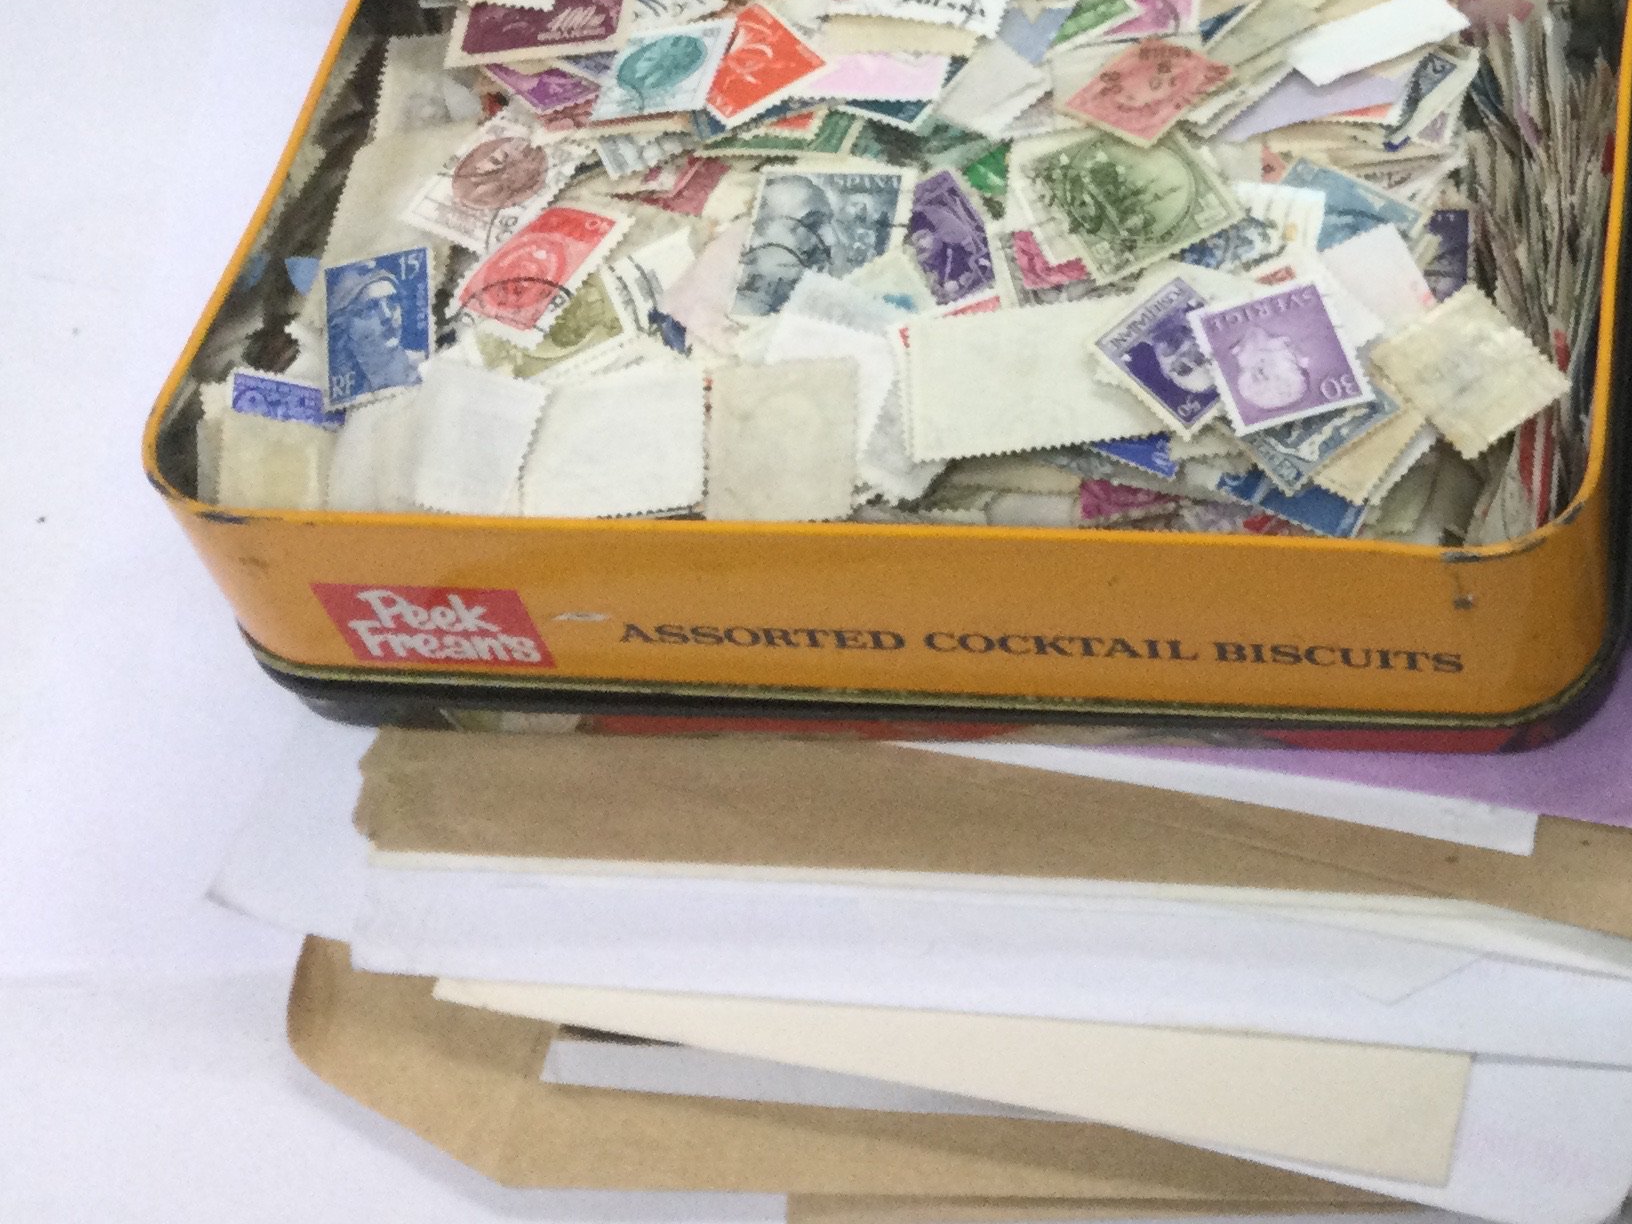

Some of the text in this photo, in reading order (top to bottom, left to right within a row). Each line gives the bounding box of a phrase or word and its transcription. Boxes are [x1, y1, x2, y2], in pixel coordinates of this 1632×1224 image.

[1210, 290, 1314, 336] SVERIGE
[332, 371, 356, 400] RF
[1319, 373, 1361, 402] 30
[355, 588, 503, 633] Peek
[619, 622, 1466, 674] ASSORTED COCKTAIL BISCUITS
